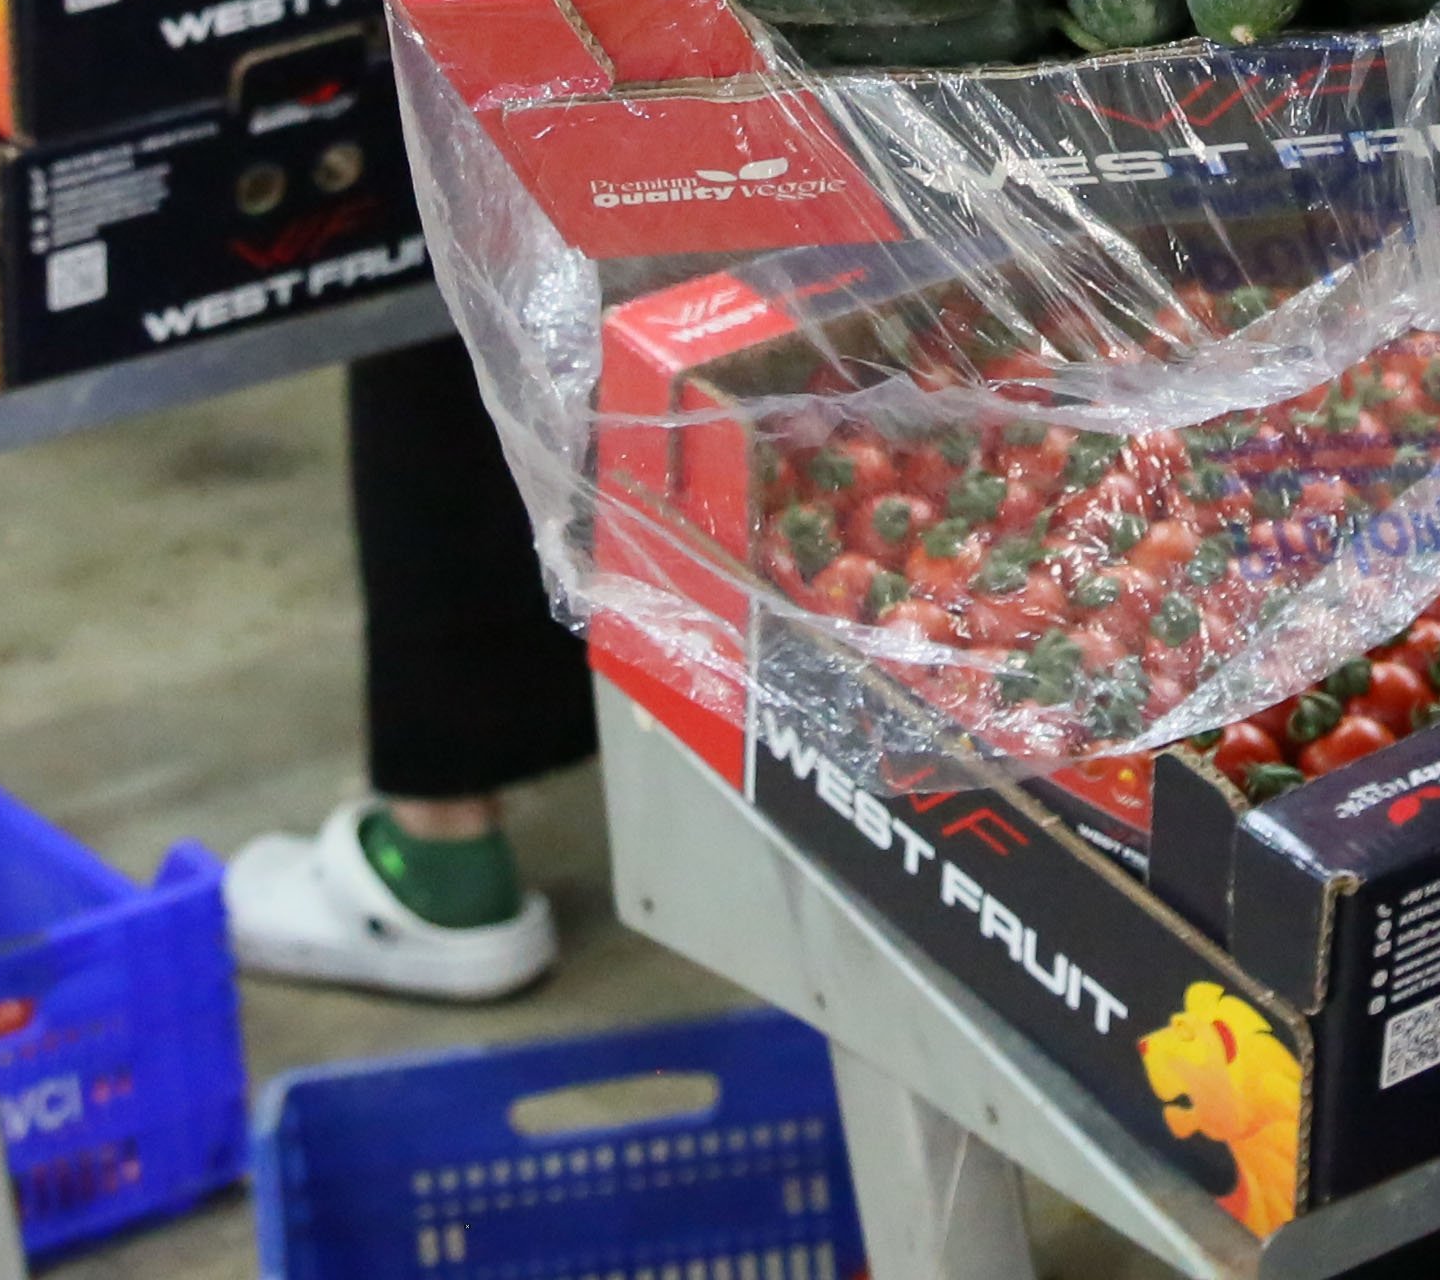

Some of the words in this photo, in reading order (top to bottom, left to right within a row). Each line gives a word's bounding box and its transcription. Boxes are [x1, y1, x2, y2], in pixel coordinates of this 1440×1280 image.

[589, 176, 699, 194] Premium
[593, 185, 736, 209] Quality
[142, 269, 304, 342] WEST
[761, 708, 937, 877] WEST
[938, 860, 1129, 1035] FRUIT
